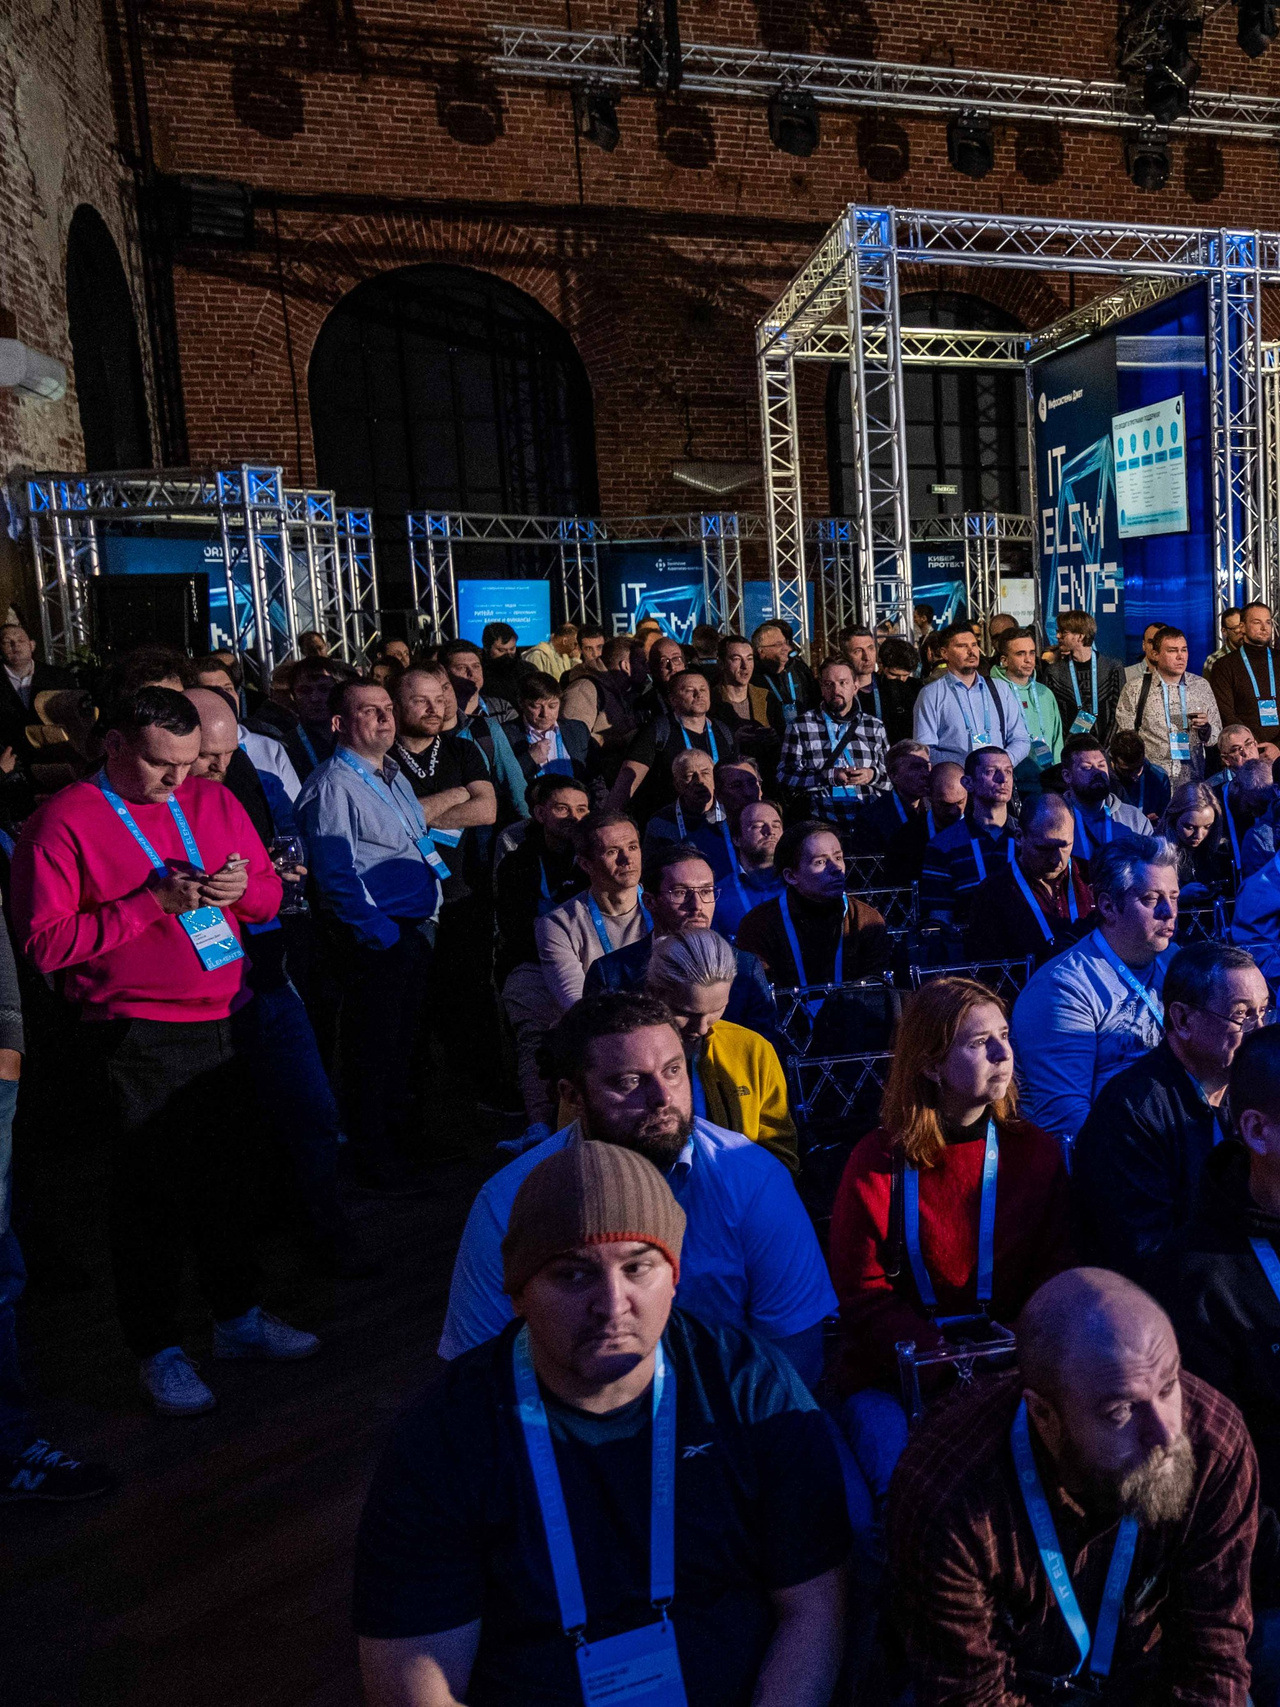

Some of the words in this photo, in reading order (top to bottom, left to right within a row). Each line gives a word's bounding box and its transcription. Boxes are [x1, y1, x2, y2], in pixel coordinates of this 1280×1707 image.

[1047, 446, 1066, 497] IT
[1042, 499, 1104, 555] ELEM
[621, 583, 647, 608] IT
[1057, 562, 1118, 613] ENTS
[126, 819, 134, 828] IT
[131, 828, 162, 866] ELEMENTS
[173, 806, 192, 845] ELEMENTS
[188, 846, 196, 855] IT
[1127, 975, 1135, 983] IT
[657, 1416, 669, 1506] ELEMENTS
[1031, 1499, 1064, 1580] ELEMENTS
[1057, 1584, 1070, 1599] IT
